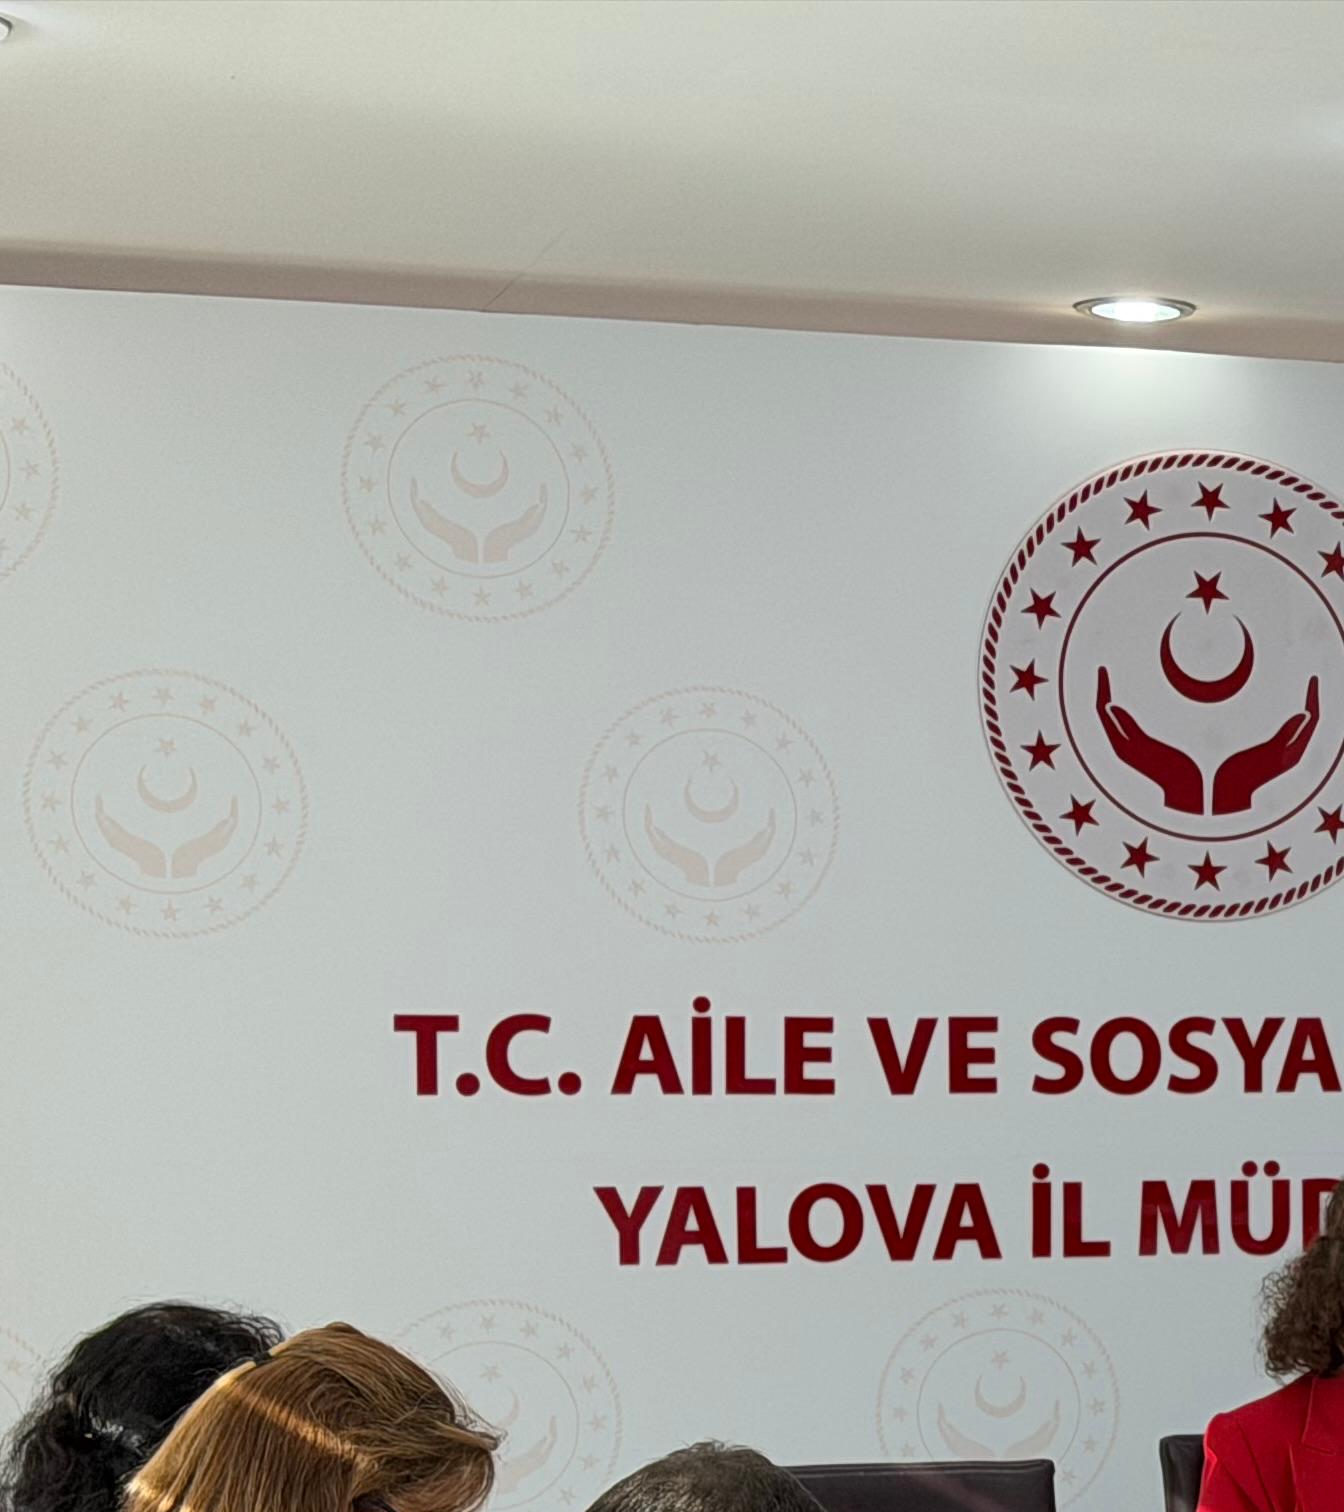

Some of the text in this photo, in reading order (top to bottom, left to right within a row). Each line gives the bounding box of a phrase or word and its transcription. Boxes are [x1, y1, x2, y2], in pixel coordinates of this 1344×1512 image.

[394, 1014, 582, 1096] T.C.
[611, 996, 836, 1096] AİLE
[867, 1017, 999, 1095] VE
[594, 1183, 1003, 1266] YALOVA
[1031, 1162, 1112, 1259] İL
